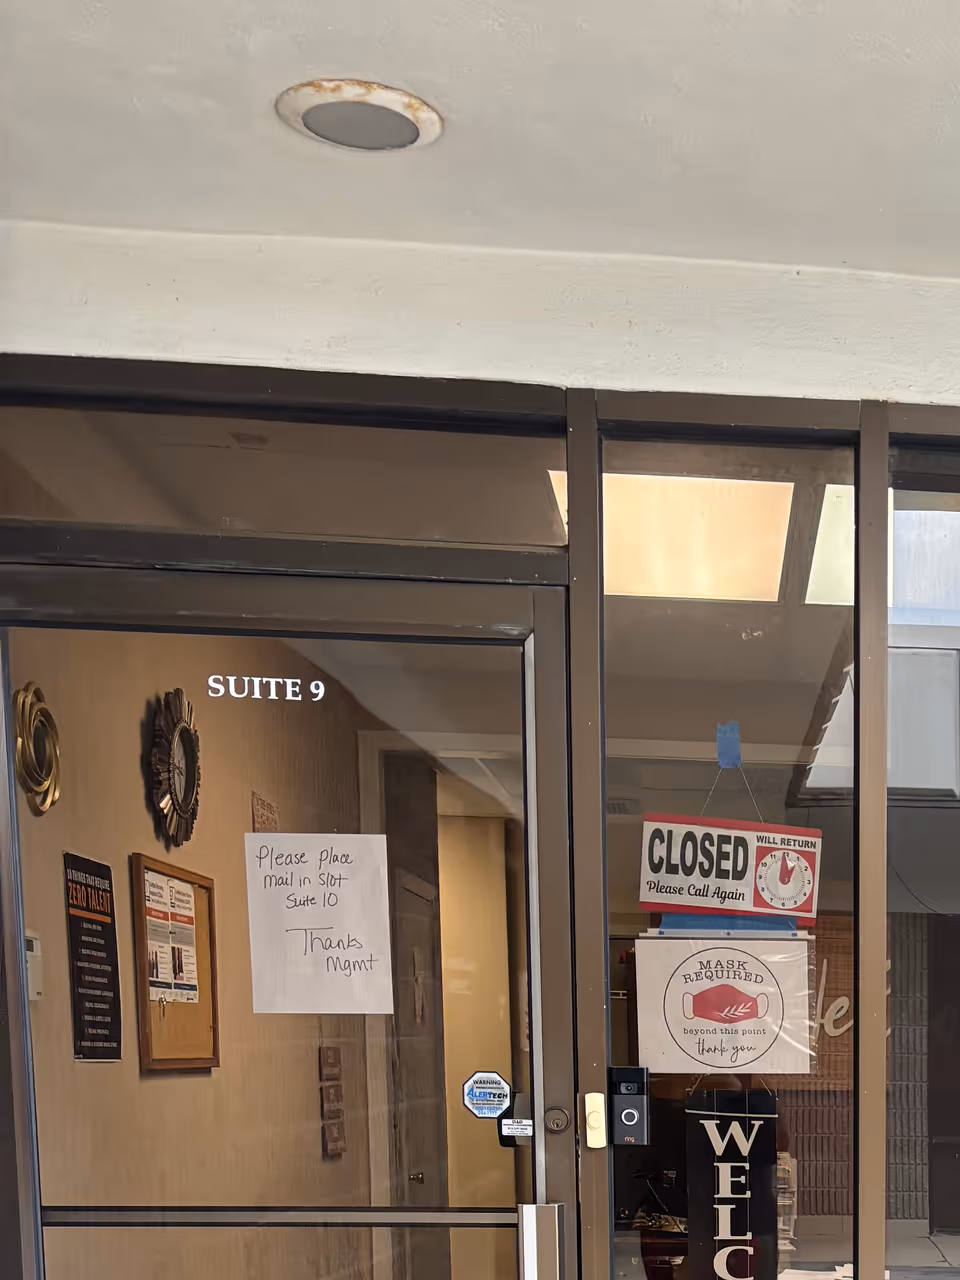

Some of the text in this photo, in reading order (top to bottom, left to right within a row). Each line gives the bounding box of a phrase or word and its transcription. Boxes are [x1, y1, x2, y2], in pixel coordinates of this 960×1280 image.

[207, 674, 325, 702] SUITE 9
[647, 827, 749, 881] CLOSED
[756, 835, 816, 849] WILL RETURN
[256, 845, 308, 870] Please
[299, 875, 311, 888] in
[646, 880, 745, 904] Please Call Again
[68, 882, 110, 914] ZERO TALENT
[286, 892, 338, 909] Suite 10
[285, 927, 363, 956] Thanks
[682, 970, 764, 984] REQUIRED
[698, 960, 749, 971] MASK
[683, 1027, 767, 1036] beyond this point
[695, 1038, 757, 1063] thank you
